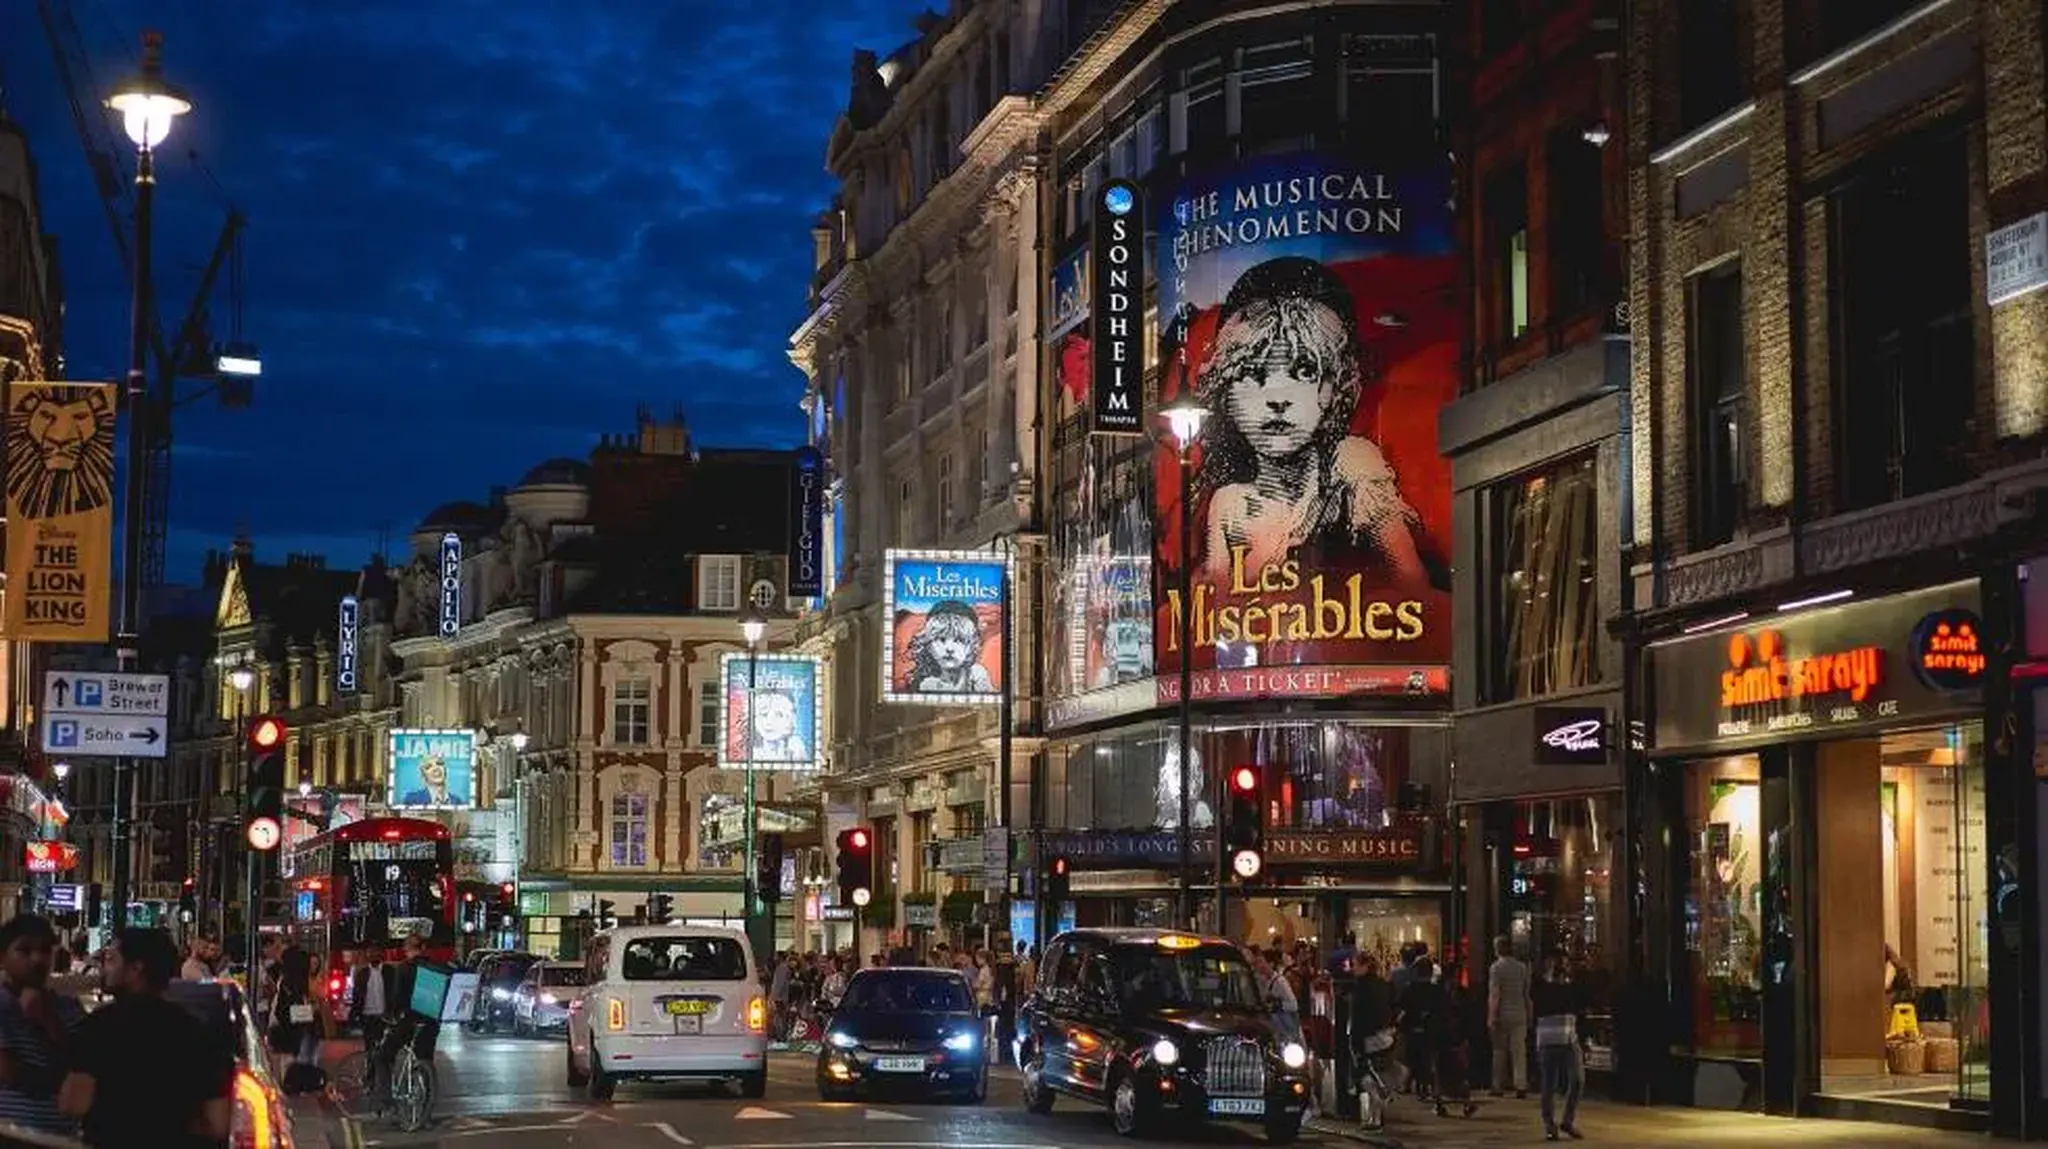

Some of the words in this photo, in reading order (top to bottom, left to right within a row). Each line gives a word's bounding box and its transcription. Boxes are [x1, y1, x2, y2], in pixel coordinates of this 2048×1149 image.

[1234, 174, 1392, 212] MUSICAL
[1172, 207, 1402, 261] PHENOMENON
[1109, 219, 1129, 410] SONDHEIM
[798, 472, 815, 581] GIELGUD
[34, 544, 77, 563] THE
[27, 571, 85, 591] LION
[936, 565, 960, 582] Les
[1230, 546, 1299, 595] Les
[443, 548, 458, 634] APOLLO
[25, 599, 85, 619] KING
[1167, 571, 1424, 651] Misérables
[340, 612, 354, 685] LYRIC
[1722, 628, 1788, 707] simit
[108, 678, 163, 693] Brewer
[1217, 674, 1231, 692] A
[110, 695, 160, 710] Street
[84, 726, 124, 742] Soho
[396, 736, 470, 758] JAMIE
[1128, 838, 1215, 854] LONGST
[385, 864, 400, 881] 19
